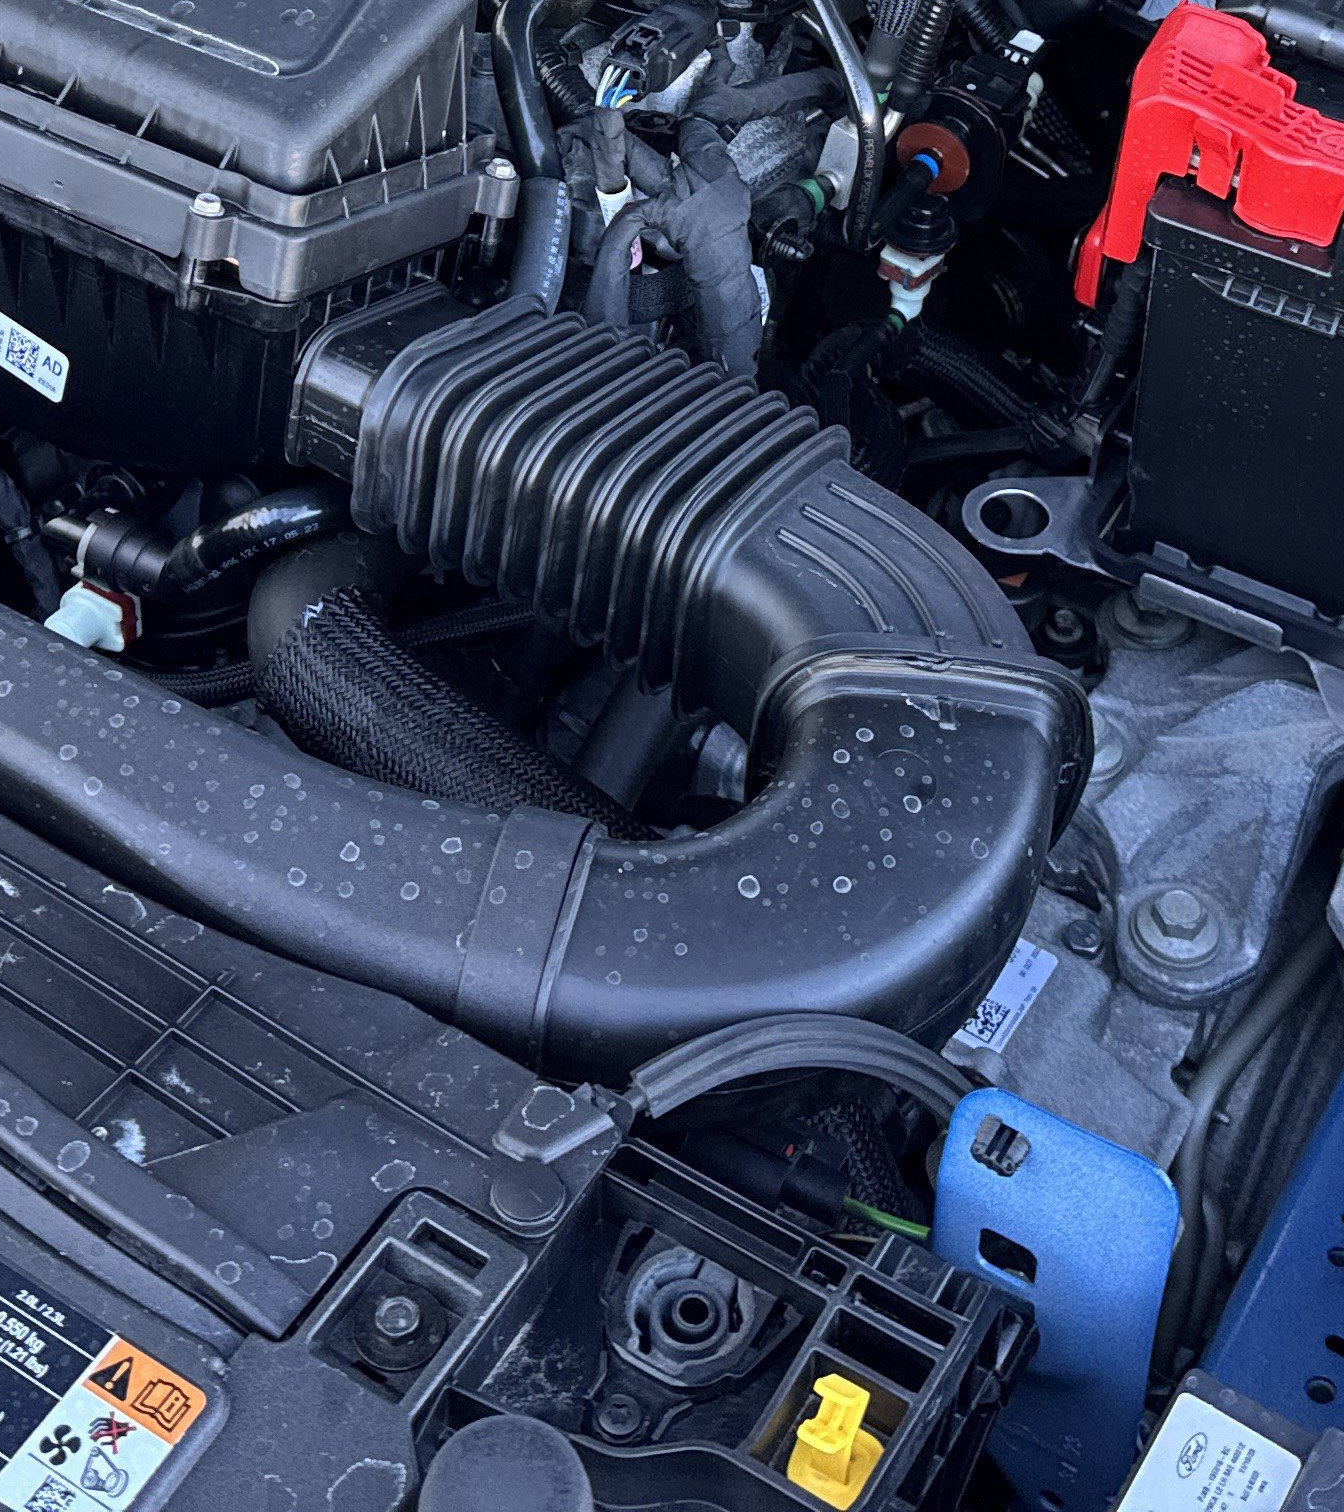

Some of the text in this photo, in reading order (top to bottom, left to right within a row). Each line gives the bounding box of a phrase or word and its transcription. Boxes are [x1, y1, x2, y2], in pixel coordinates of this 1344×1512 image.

[41, 355, 65, 377] AD
[22, 1331, 47, 1354] kg
[22, 1355, 49, 1378] lbs)
[1176, 1436, 1206, 1472] Ford
